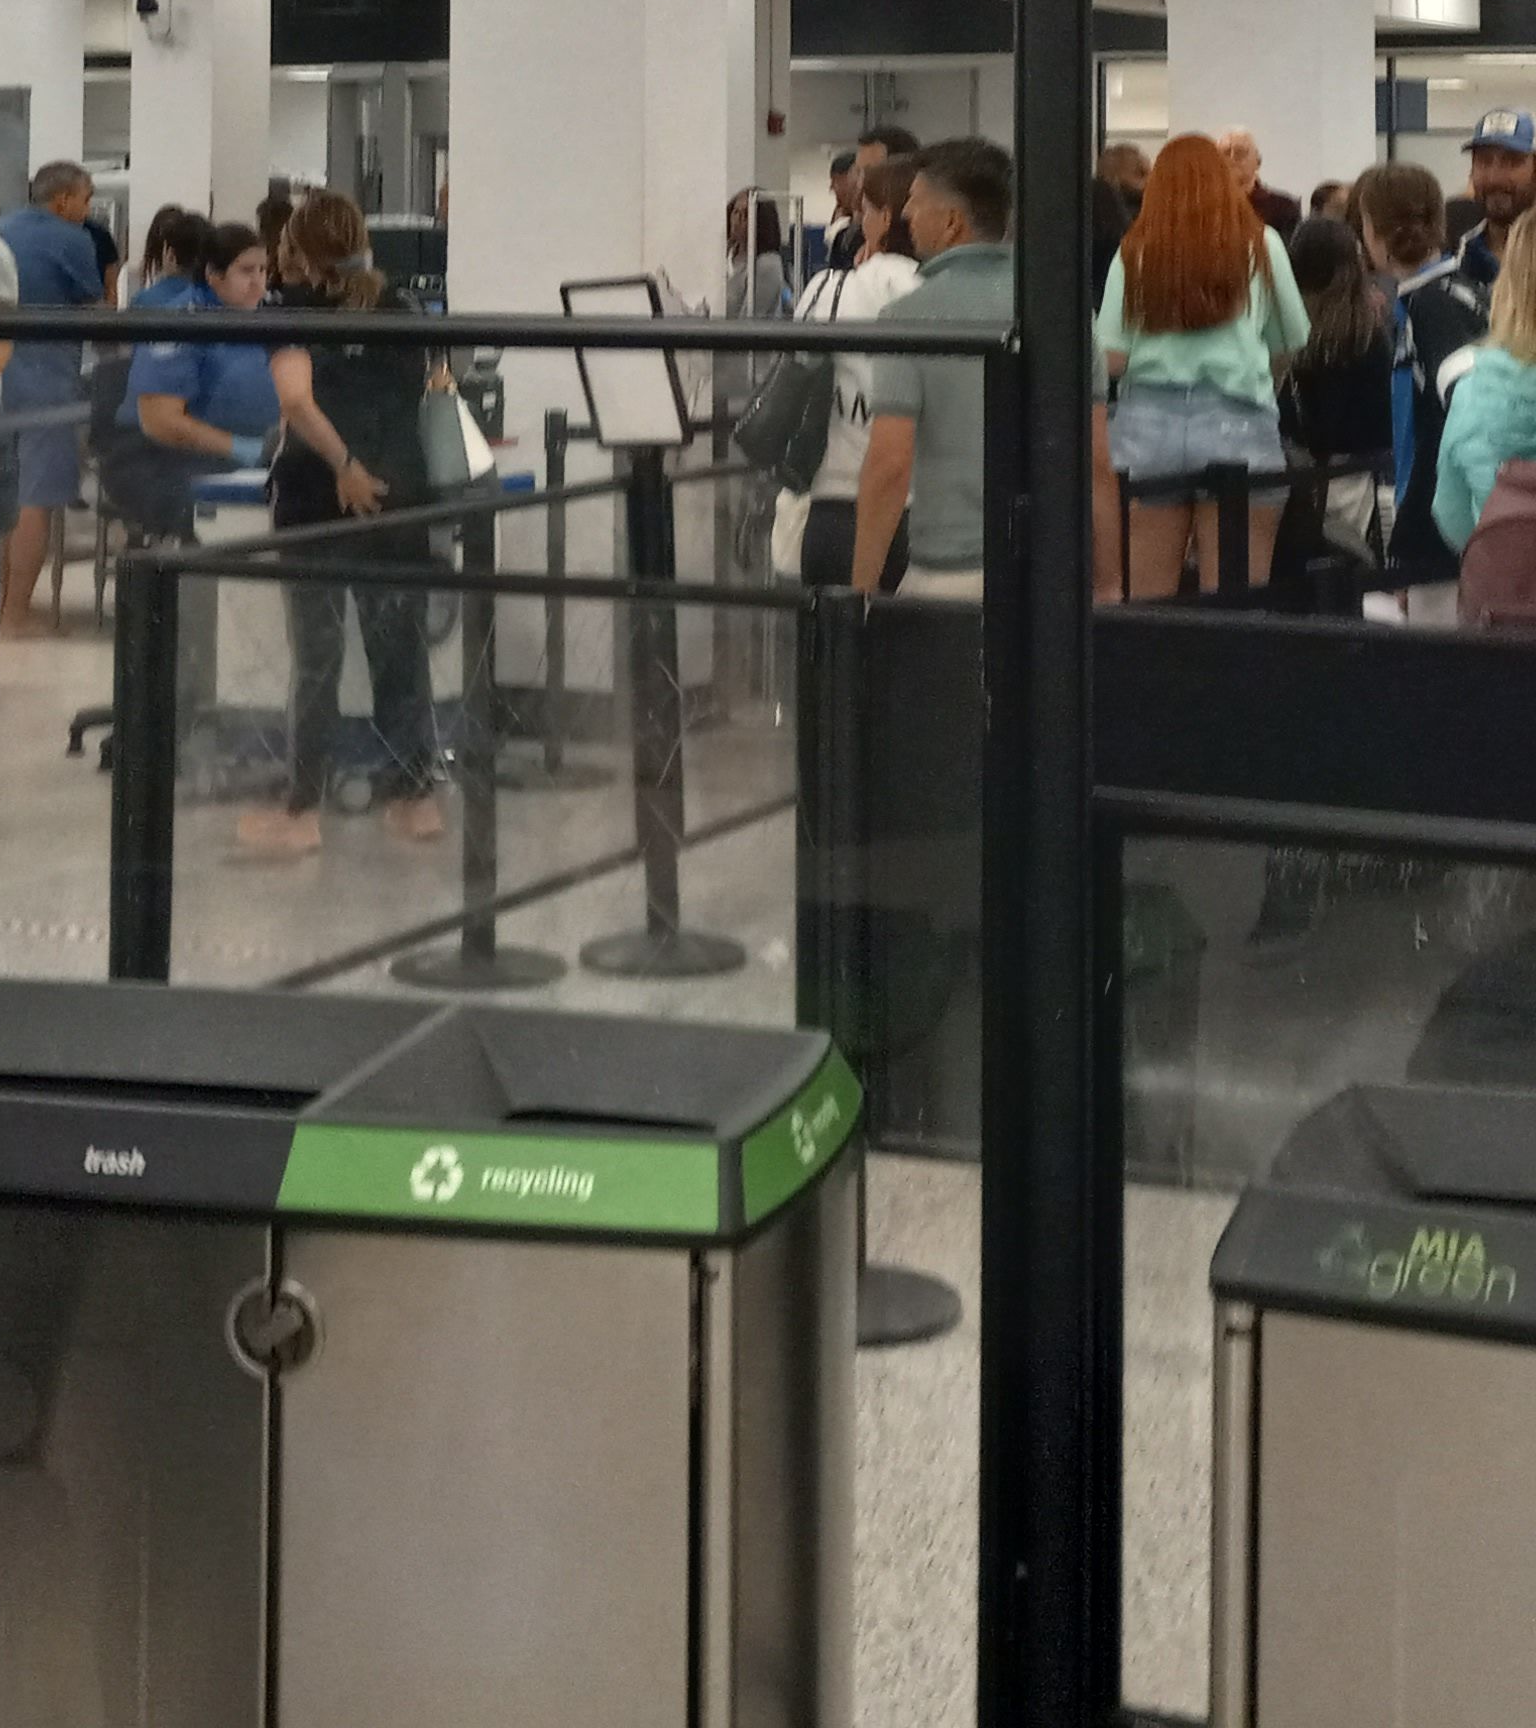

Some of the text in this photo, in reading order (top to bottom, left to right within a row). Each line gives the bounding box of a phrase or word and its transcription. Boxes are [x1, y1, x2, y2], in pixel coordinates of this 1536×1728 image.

[84, 1143, 146, 1177] trash
[481, 1165, 595, 1203] recycling
[1412, 1224, 1486, 1266] MIA
